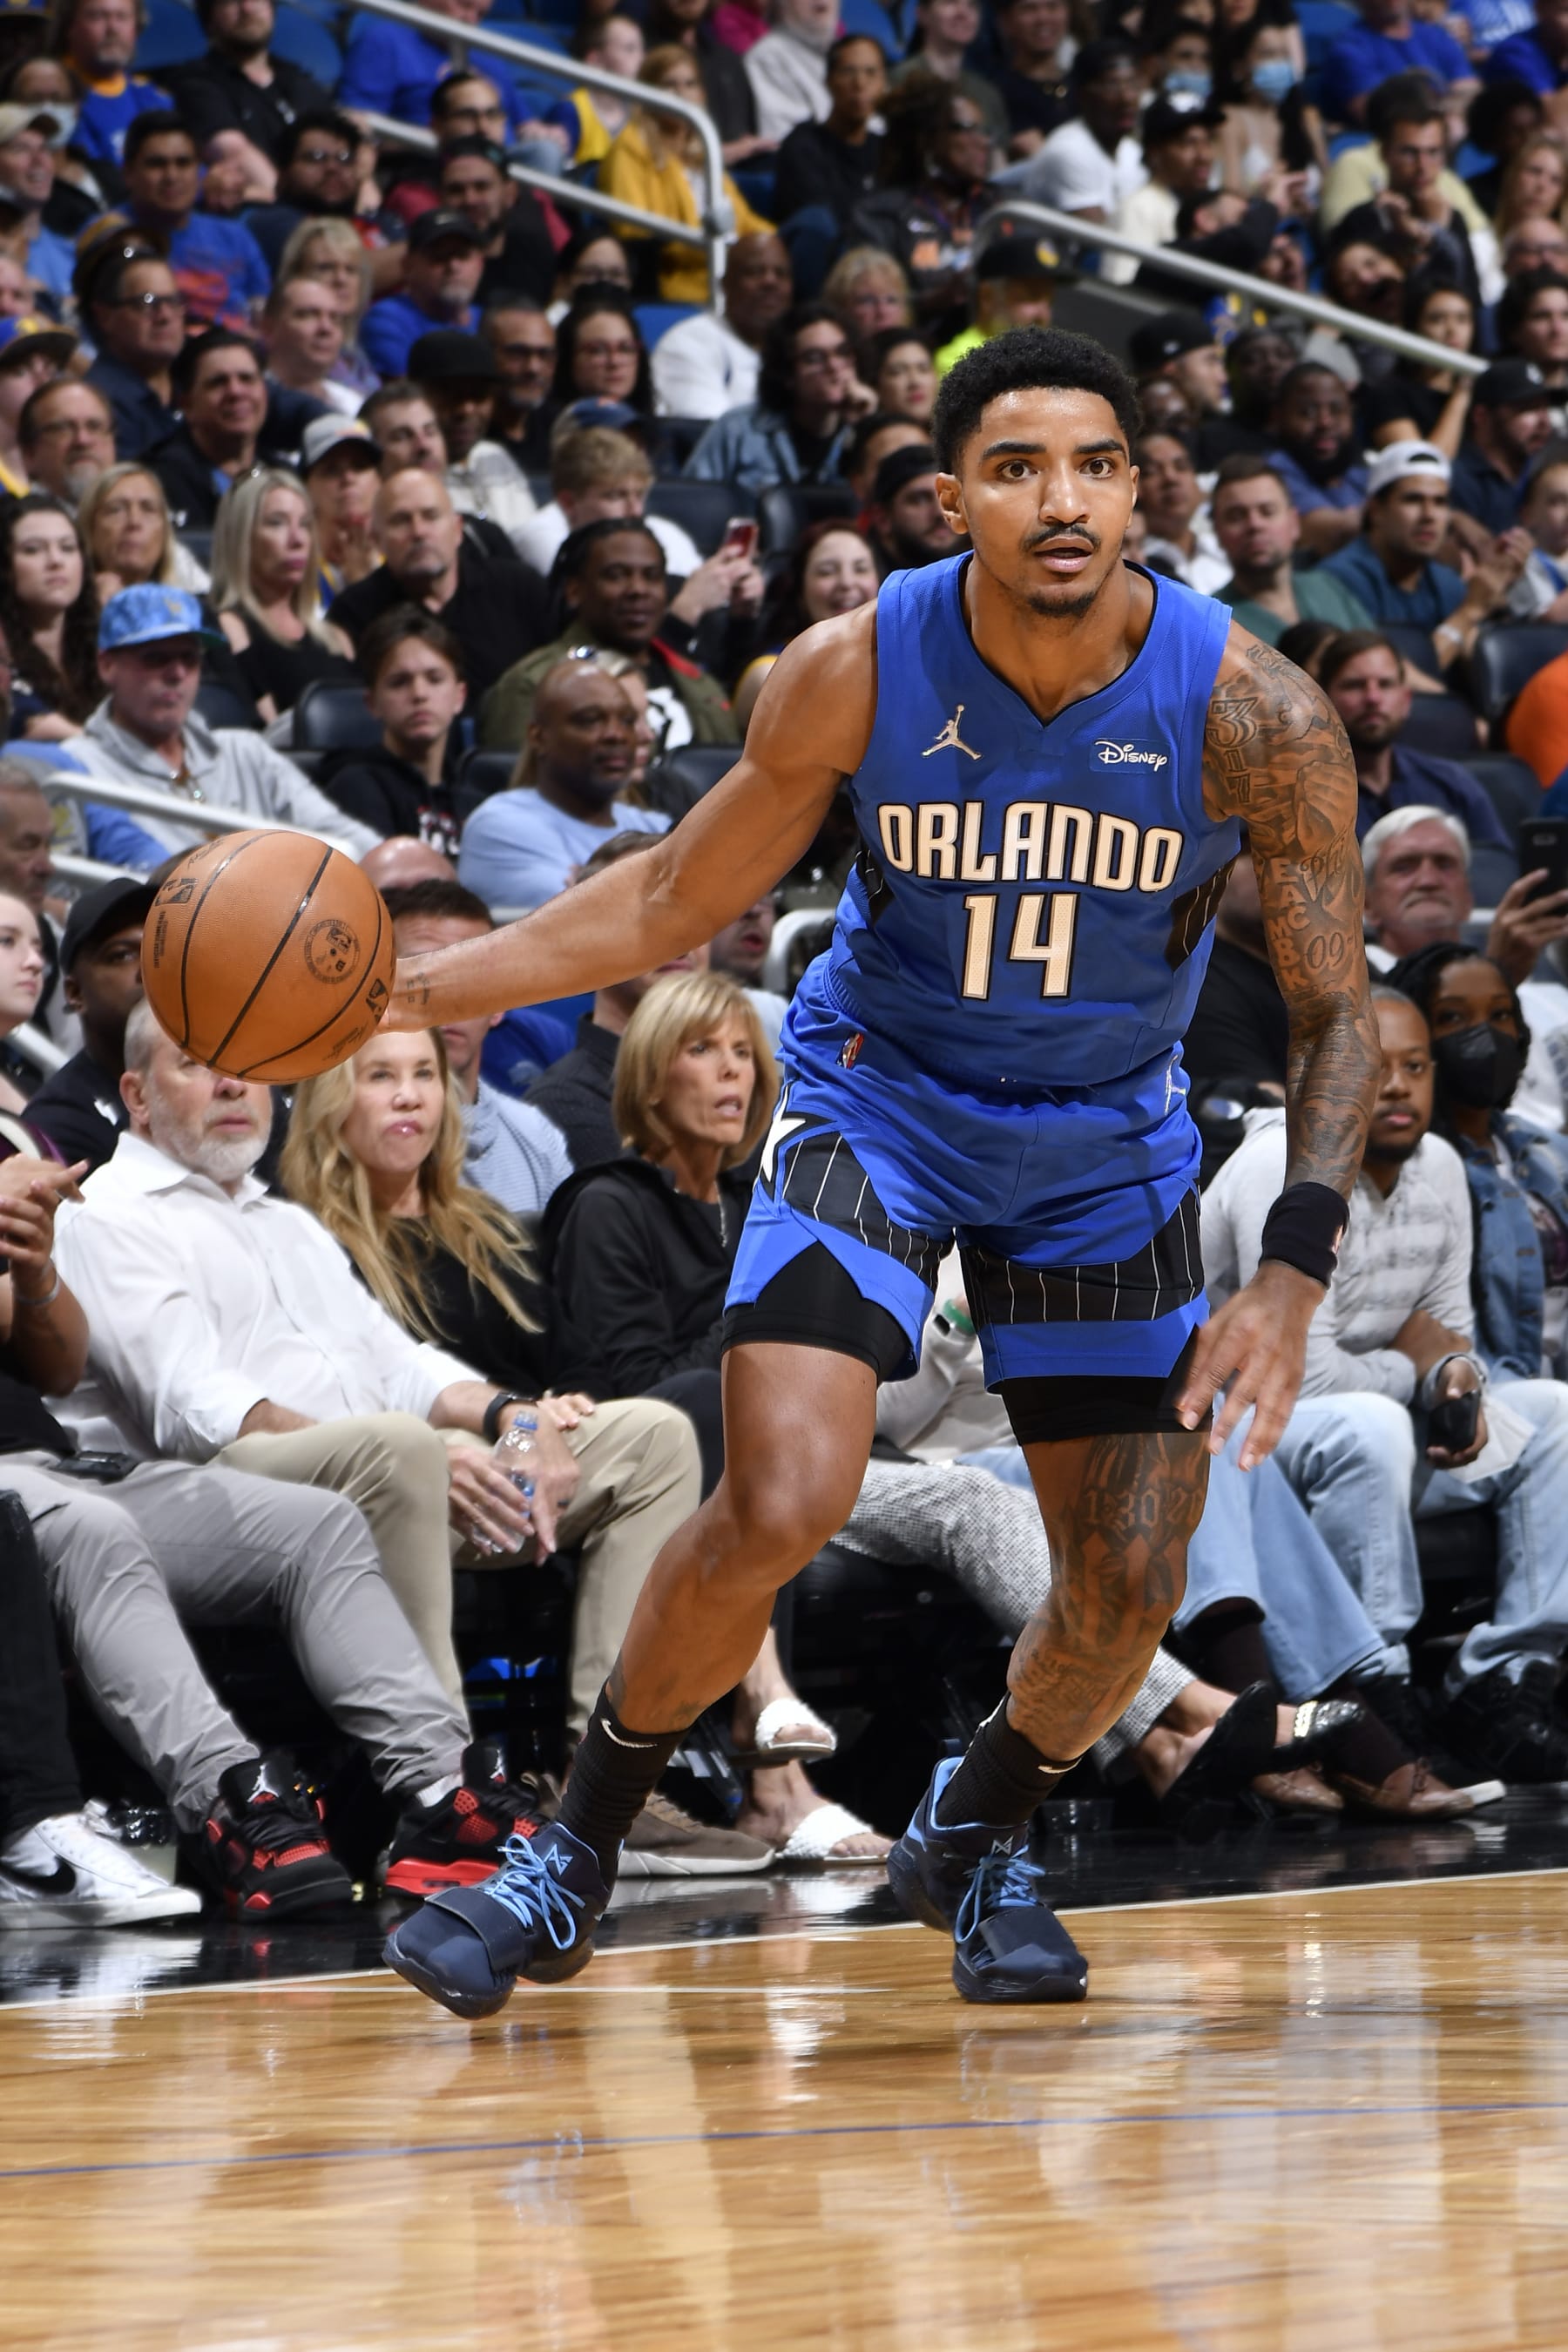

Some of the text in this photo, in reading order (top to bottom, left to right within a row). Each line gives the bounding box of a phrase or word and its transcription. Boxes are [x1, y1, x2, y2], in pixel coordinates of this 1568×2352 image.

[1094, 740, 1168, 772] Disney
[877, 801, 1184, 893] ORLANDO
[962, 892, 1078, 1001] 14
